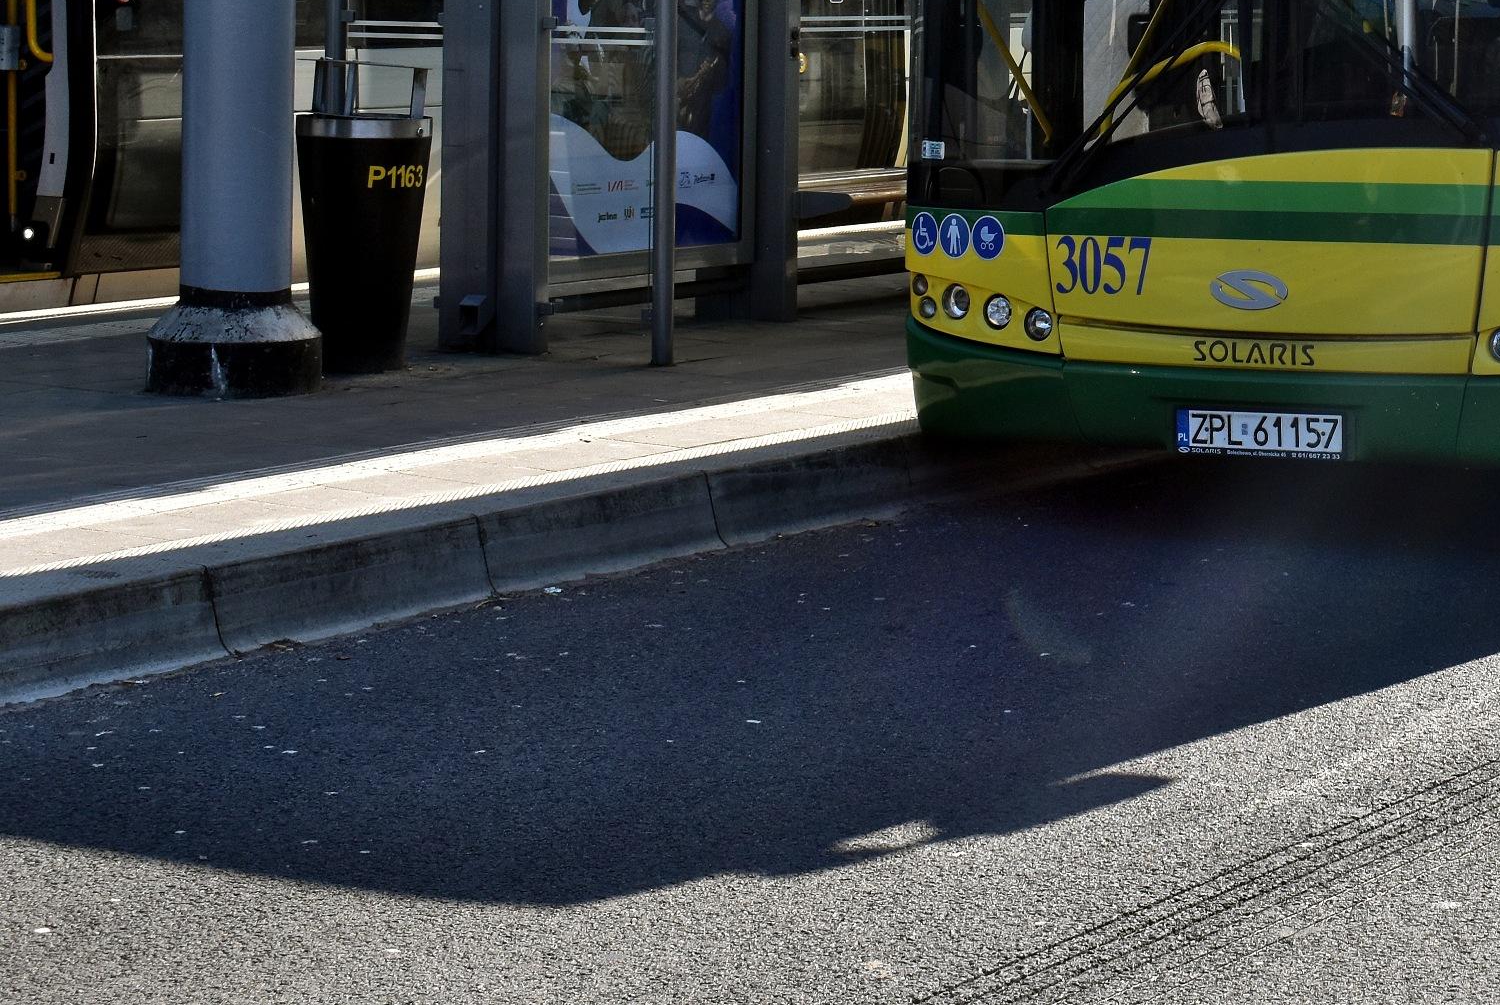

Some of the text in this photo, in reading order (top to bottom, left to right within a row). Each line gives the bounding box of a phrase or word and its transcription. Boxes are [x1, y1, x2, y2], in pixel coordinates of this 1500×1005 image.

[367, 165, 424, 188] P1163
[1055, 235, 1152, 296] 3057
[1193, 340, 1315, 366] SOLARIS
[1177, 433, 1188, 442] PL
[1191, 413, 1339, 449] ZPL 61157
